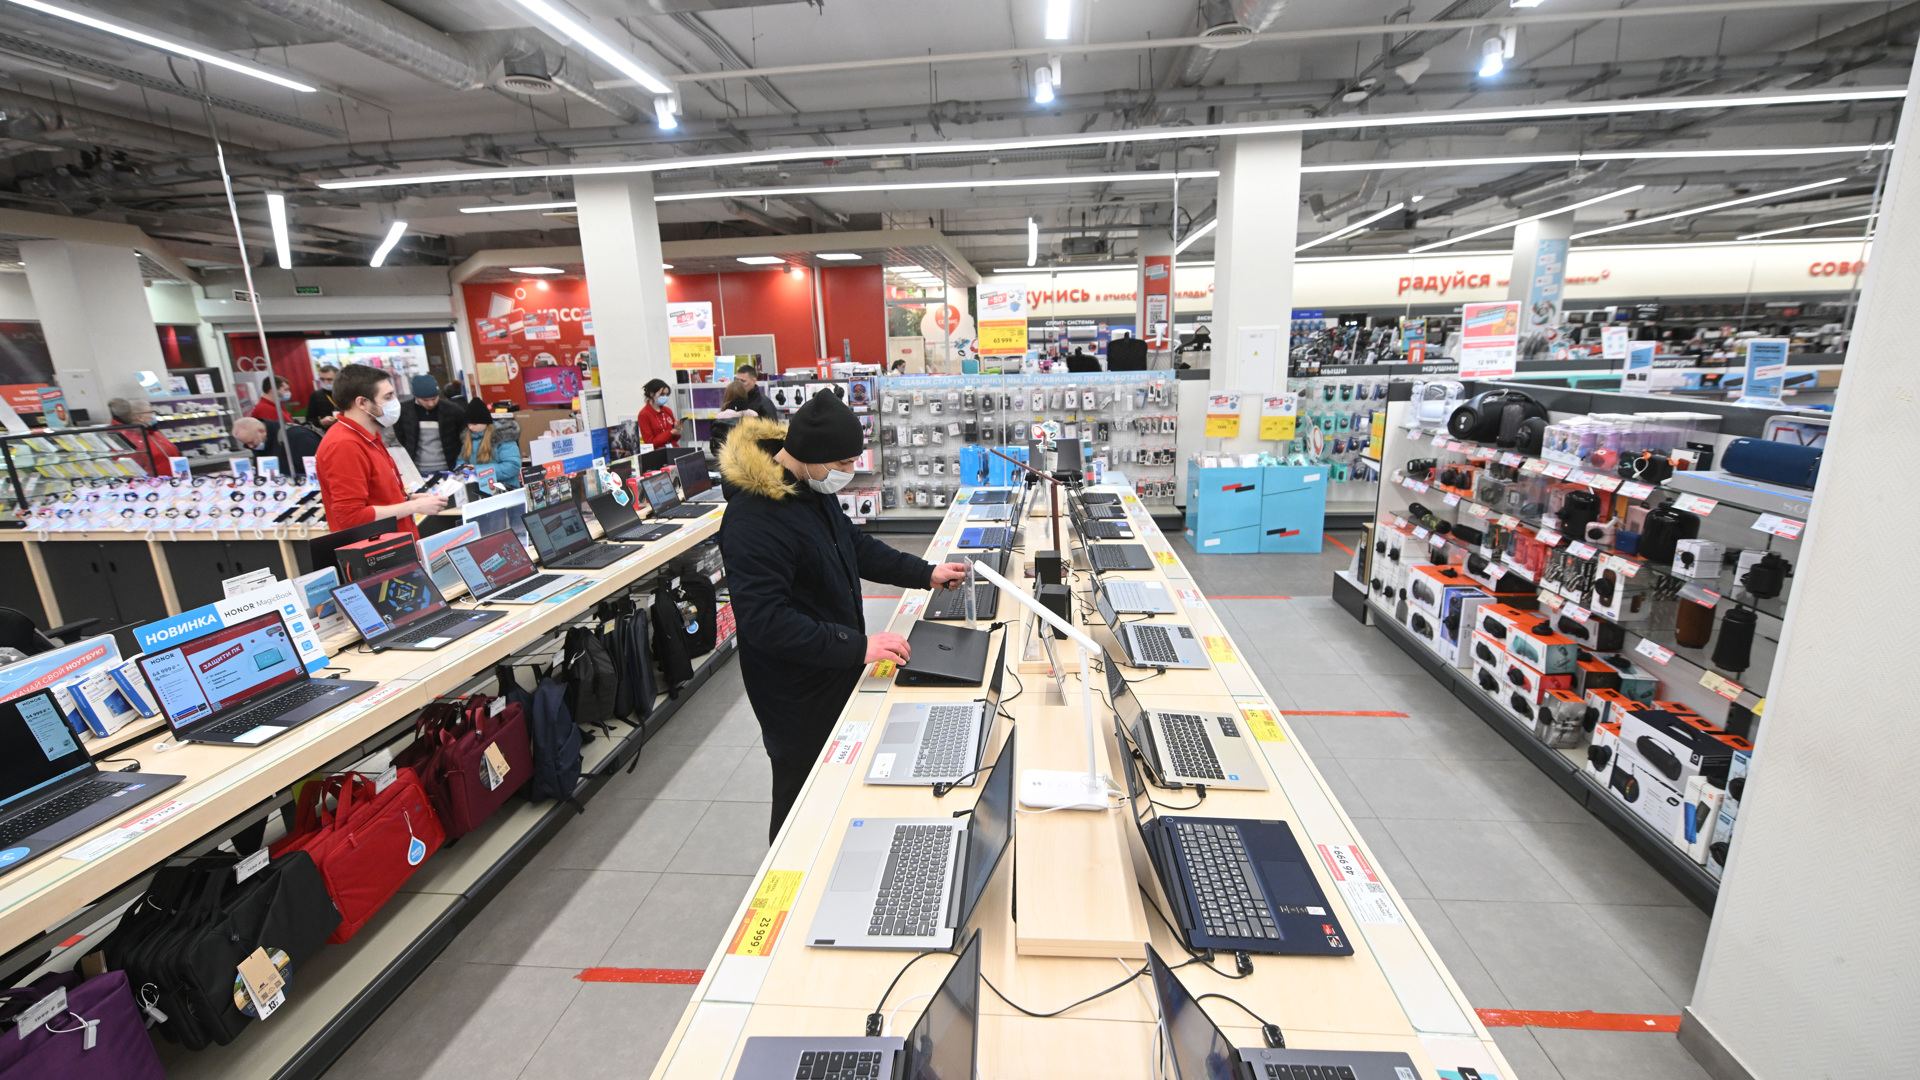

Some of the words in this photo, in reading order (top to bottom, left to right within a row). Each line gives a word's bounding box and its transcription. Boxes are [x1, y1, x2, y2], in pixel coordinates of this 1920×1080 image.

[1398, 270, 1490, 295] радуйся
[900, 378, 931, 386] СДАВАЙ
[933, 378, 965, 386] СТАРУЮ
[1034, 375, 1083, 383] ПРАВИЛЬНО
[1783, 501, 1811, 514] SO
[224, 602, 256, 618] HONOR
[255, 590, 293, 607] MagicBook
[145, 613, 217, 646] НОВИНКА
[150, 652, 175, 666] HONOR
[202, 650, 232, 670] ЗАЩИТИ
[231, 645, 241, 656] ПК
[42, 667, 66, 684] СВОЙ
[65, 647, 104, 671] НОУТБУК!
[22, 696, 42, 707] HONOR
[1333, 850, 1349, 864] 999
[1342, 865, 1355, 876] 46
[760, 917, 772, 928] 23
[750, 929, 766, 947] 999
